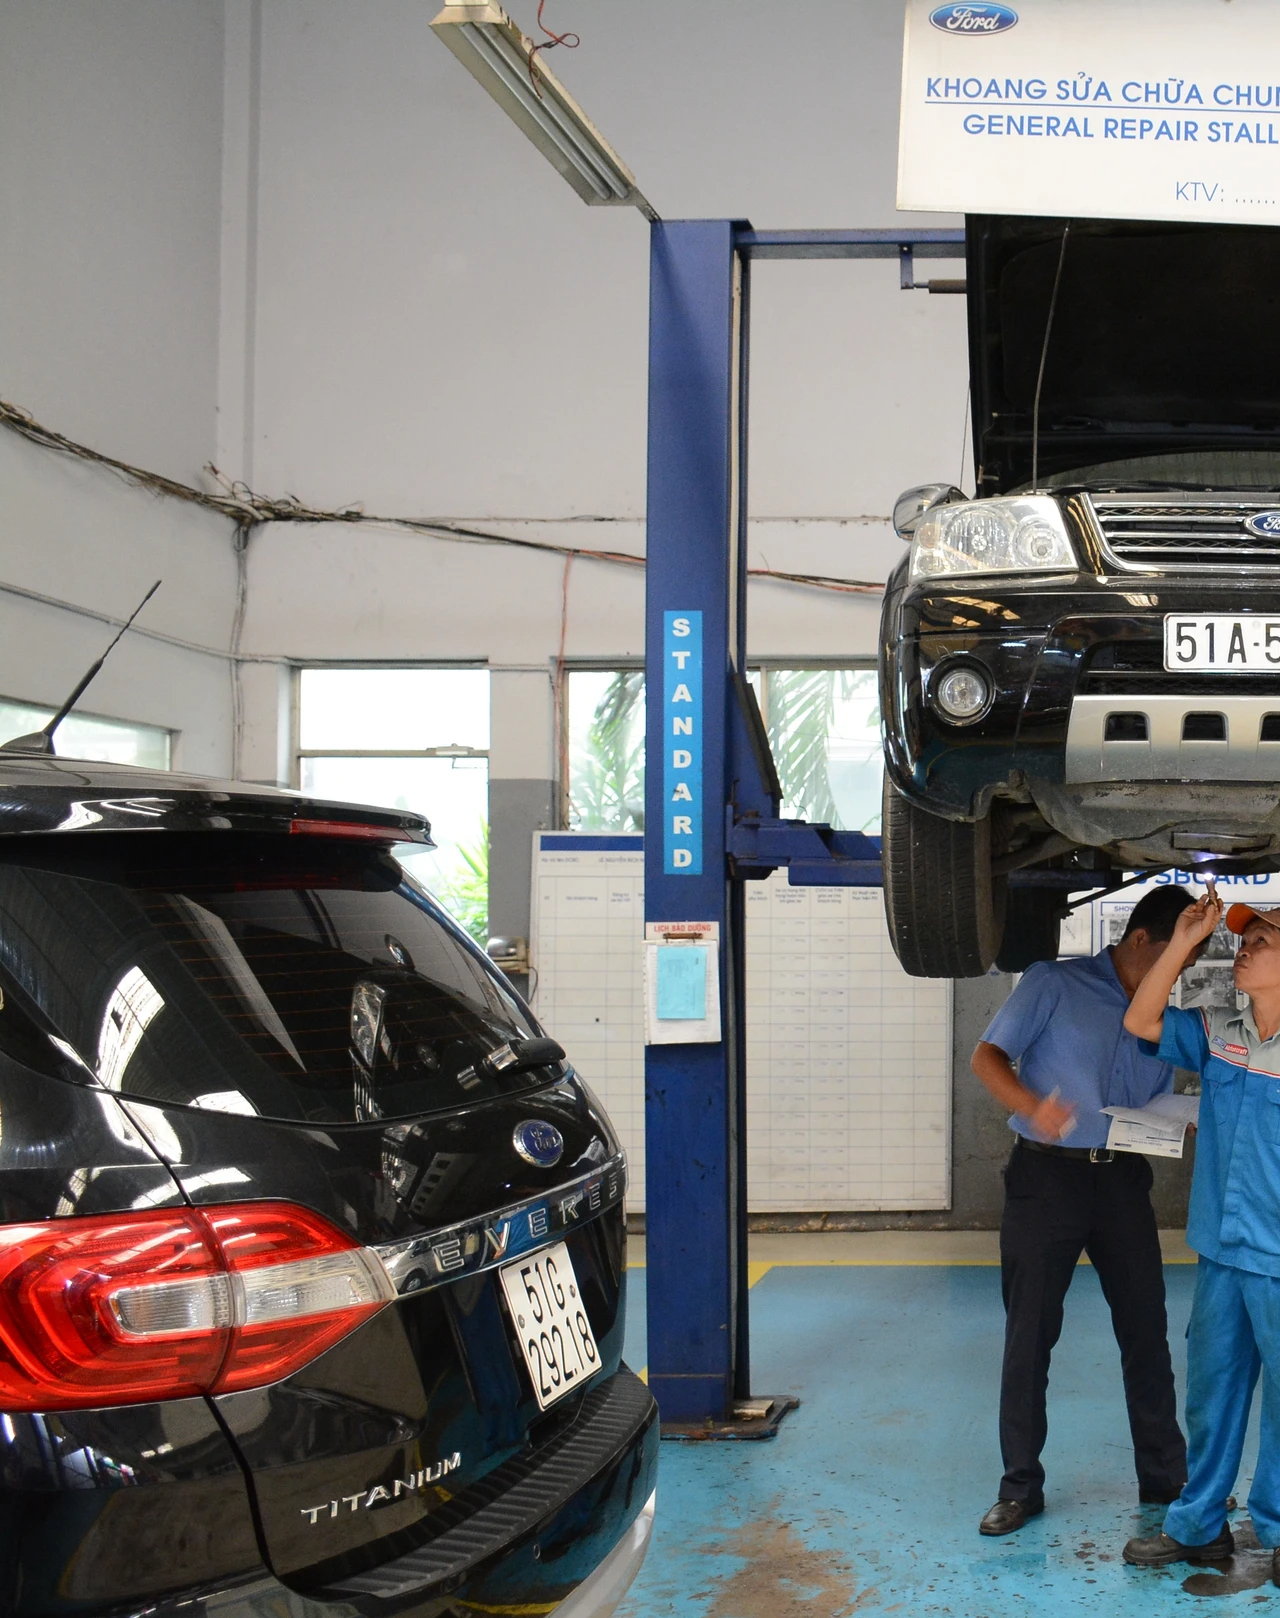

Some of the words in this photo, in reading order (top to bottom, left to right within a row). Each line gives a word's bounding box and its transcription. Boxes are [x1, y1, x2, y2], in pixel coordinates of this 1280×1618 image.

[946, 6, 1001, 30] Ford
[926, 77, 1048, 100] KHOANG
[1055, 71, 1113, 102] SỬA
[1121, 77, 1204, 105] CHỮA
[962, 114, 1095, 138] GENERAL
[1103, 118, 1199, 142] REPAIR
[1207, 121, 1279, 145] STALL
[1175, 181, 1224, 202] KTV:
[671, 618, 693, 868] STANDARD
[519, 1256, 566, 1324] 51G
[527, 1310, 597, 1398] 292.18
[300, 1451, 462, 1524] TITANIUM
